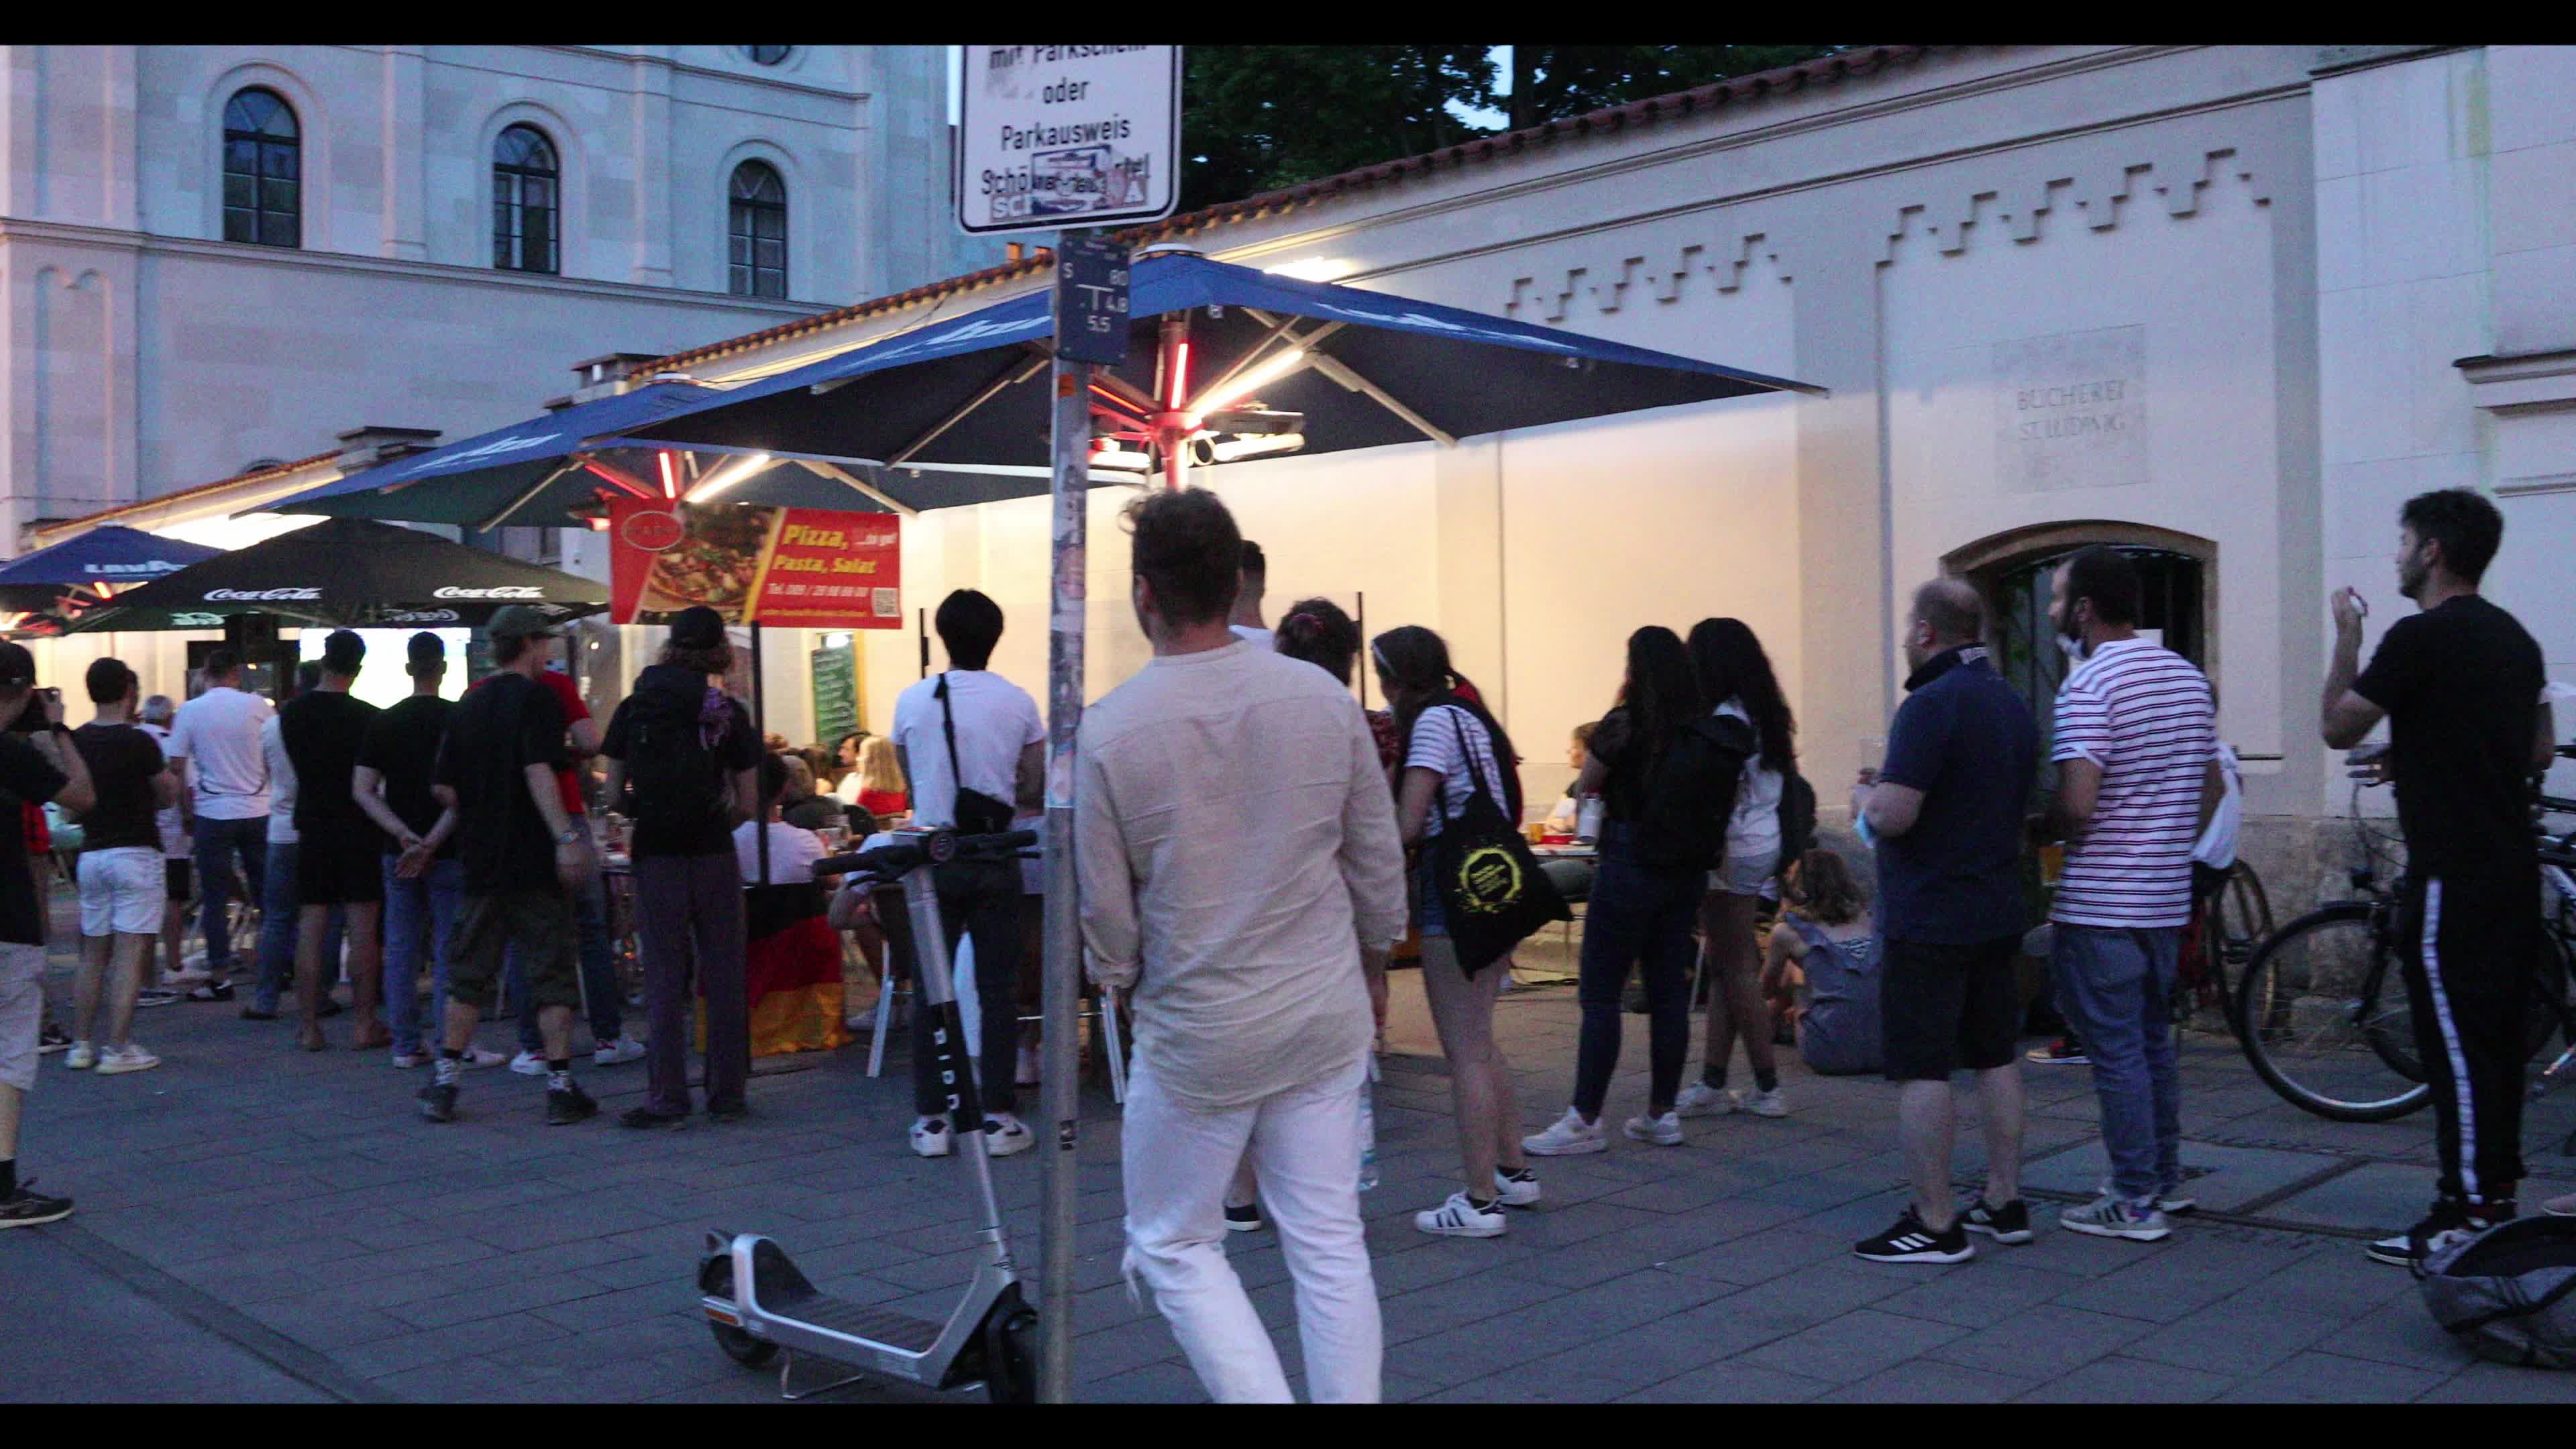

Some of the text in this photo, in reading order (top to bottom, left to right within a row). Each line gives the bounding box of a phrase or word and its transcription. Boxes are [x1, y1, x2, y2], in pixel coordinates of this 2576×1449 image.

[1042, 77, 1089, 103] oder
[1002, 113, 1130, 150] Parkausweis
[782, 524, 849, 550] Pizza,
[771, 554, 877, 574] Pasta, Salat
